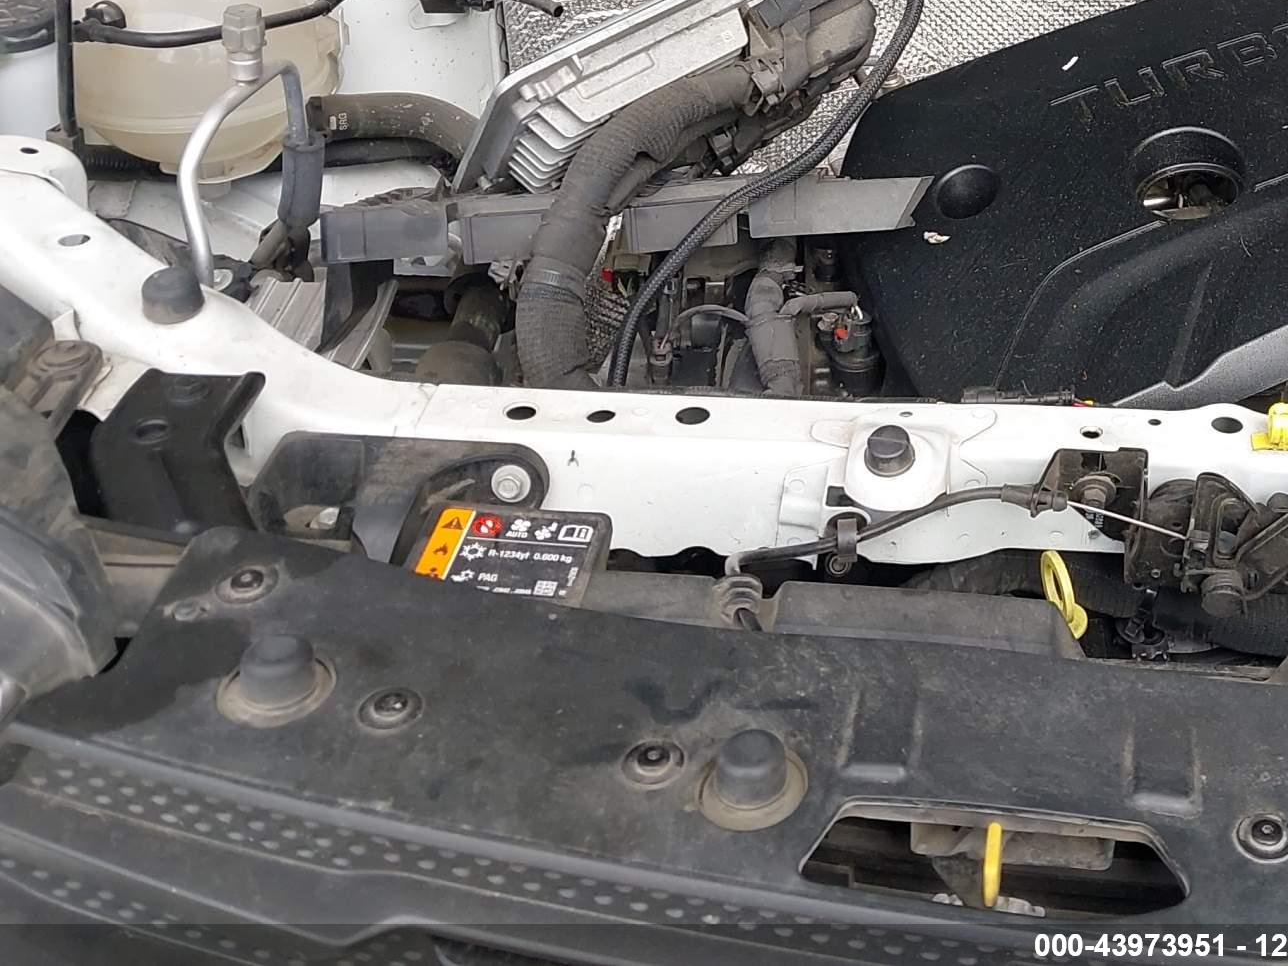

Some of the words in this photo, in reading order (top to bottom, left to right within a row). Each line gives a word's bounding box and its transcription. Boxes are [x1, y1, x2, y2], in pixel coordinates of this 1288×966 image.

[505, 531, 528, 539] AUTO
[487, 549, 530, 560] R-1234yf
[533, 552, 559, 561] 0.600
[560, 554, 573, 564] kg
[478, 572, 498, 582] PAG
